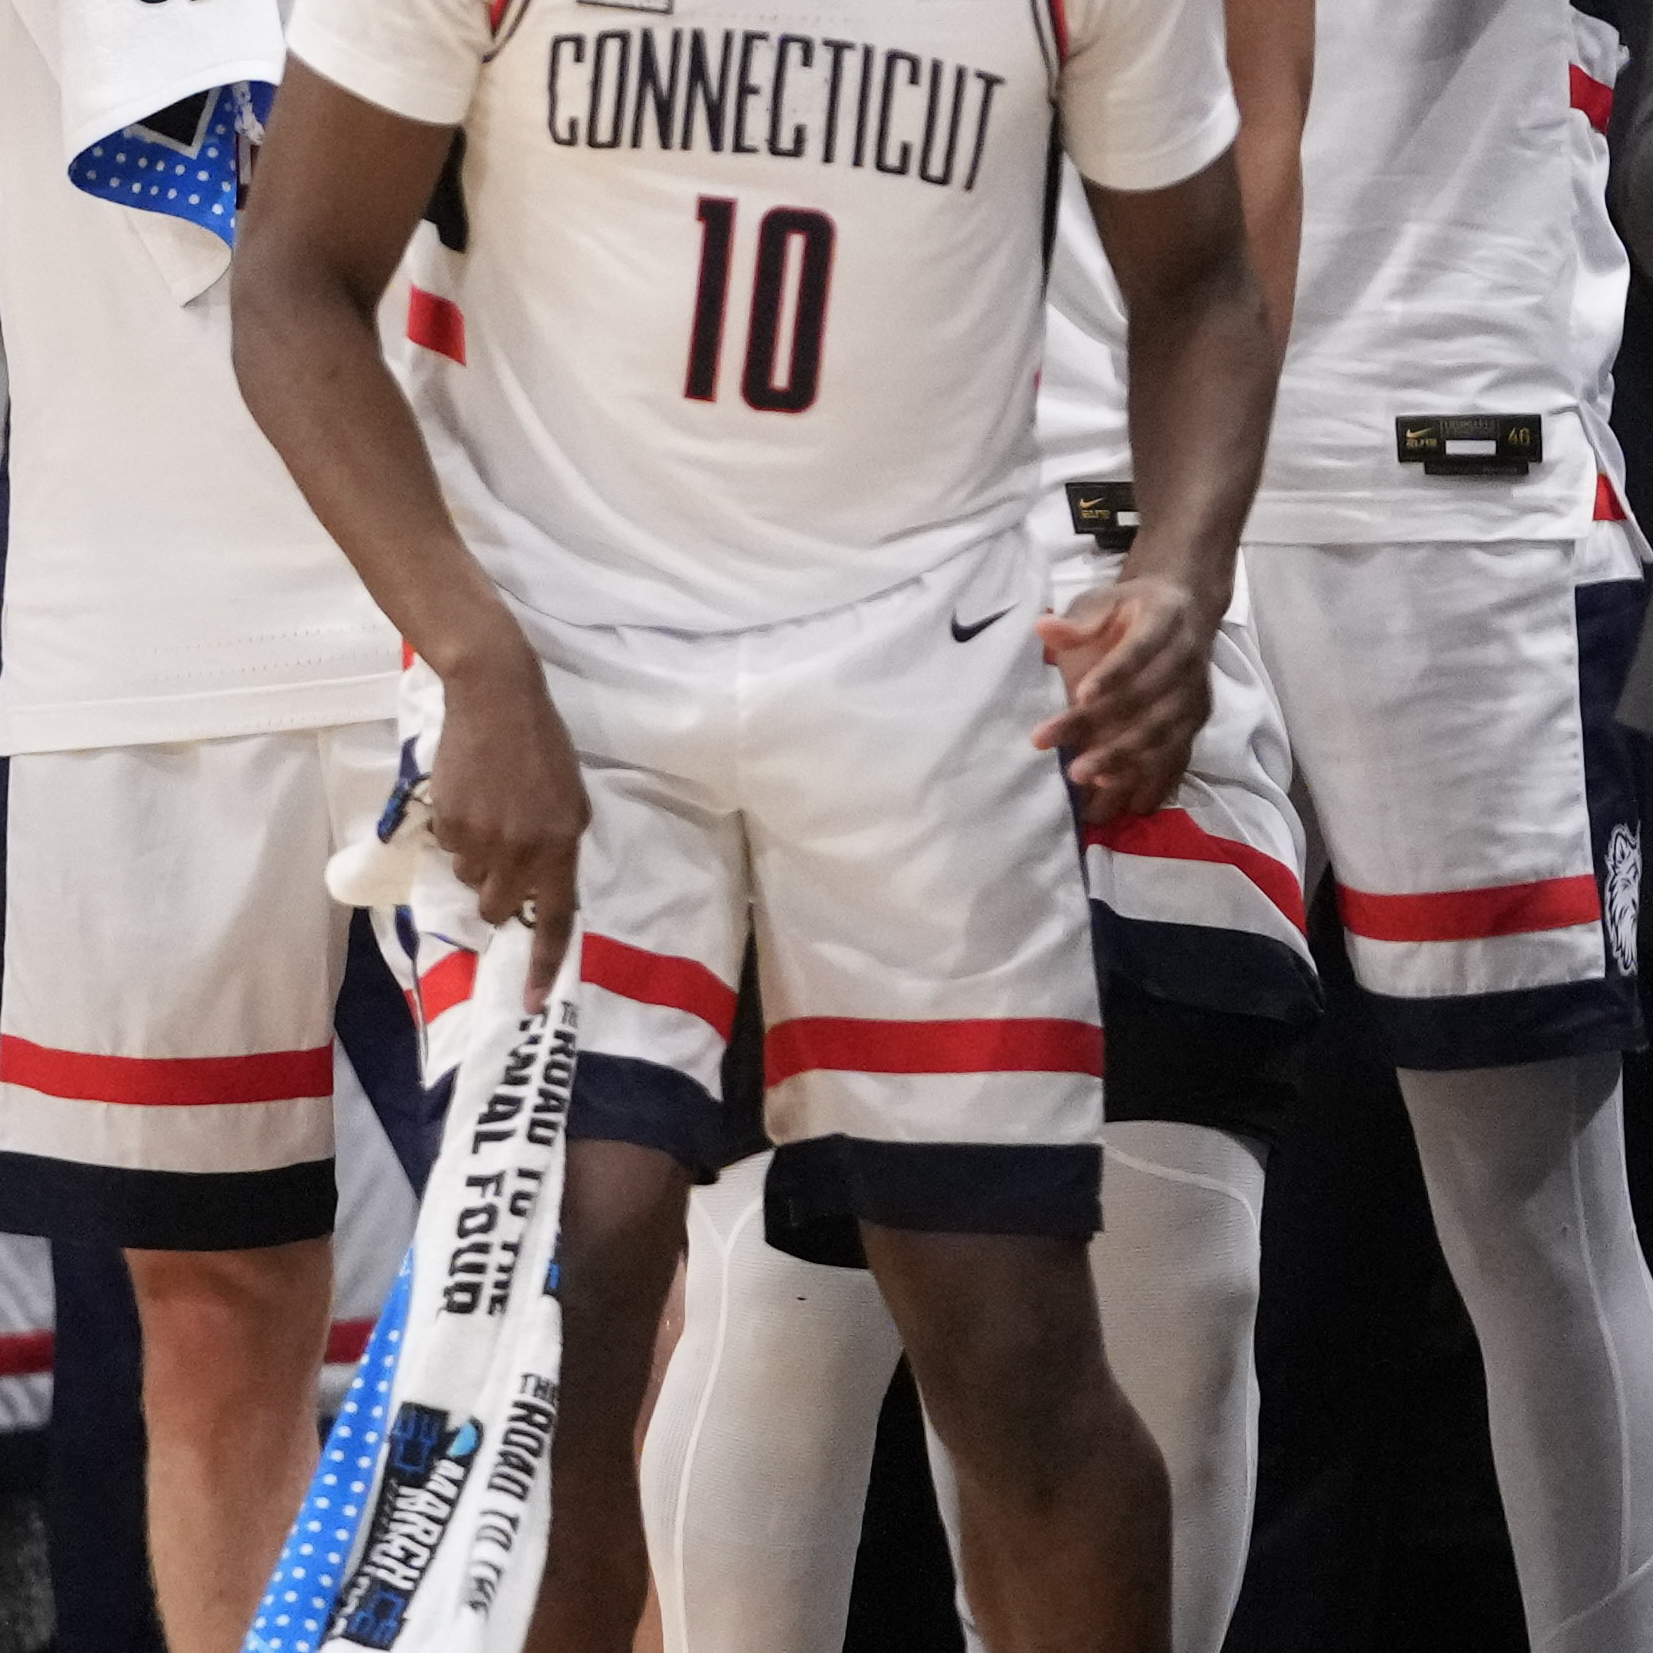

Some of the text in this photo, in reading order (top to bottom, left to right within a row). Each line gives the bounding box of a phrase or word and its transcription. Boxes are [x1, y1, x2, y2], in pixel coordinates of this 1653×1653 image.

[546, 26, 1006, 193] CONNECTICUT
[684, 193, 837, 414] 10
[526, 1029, 576, 1147] ROAD
[487, 1399, 556, 1503] ROAD
[363, 1457, 467, 1593] MARCH
